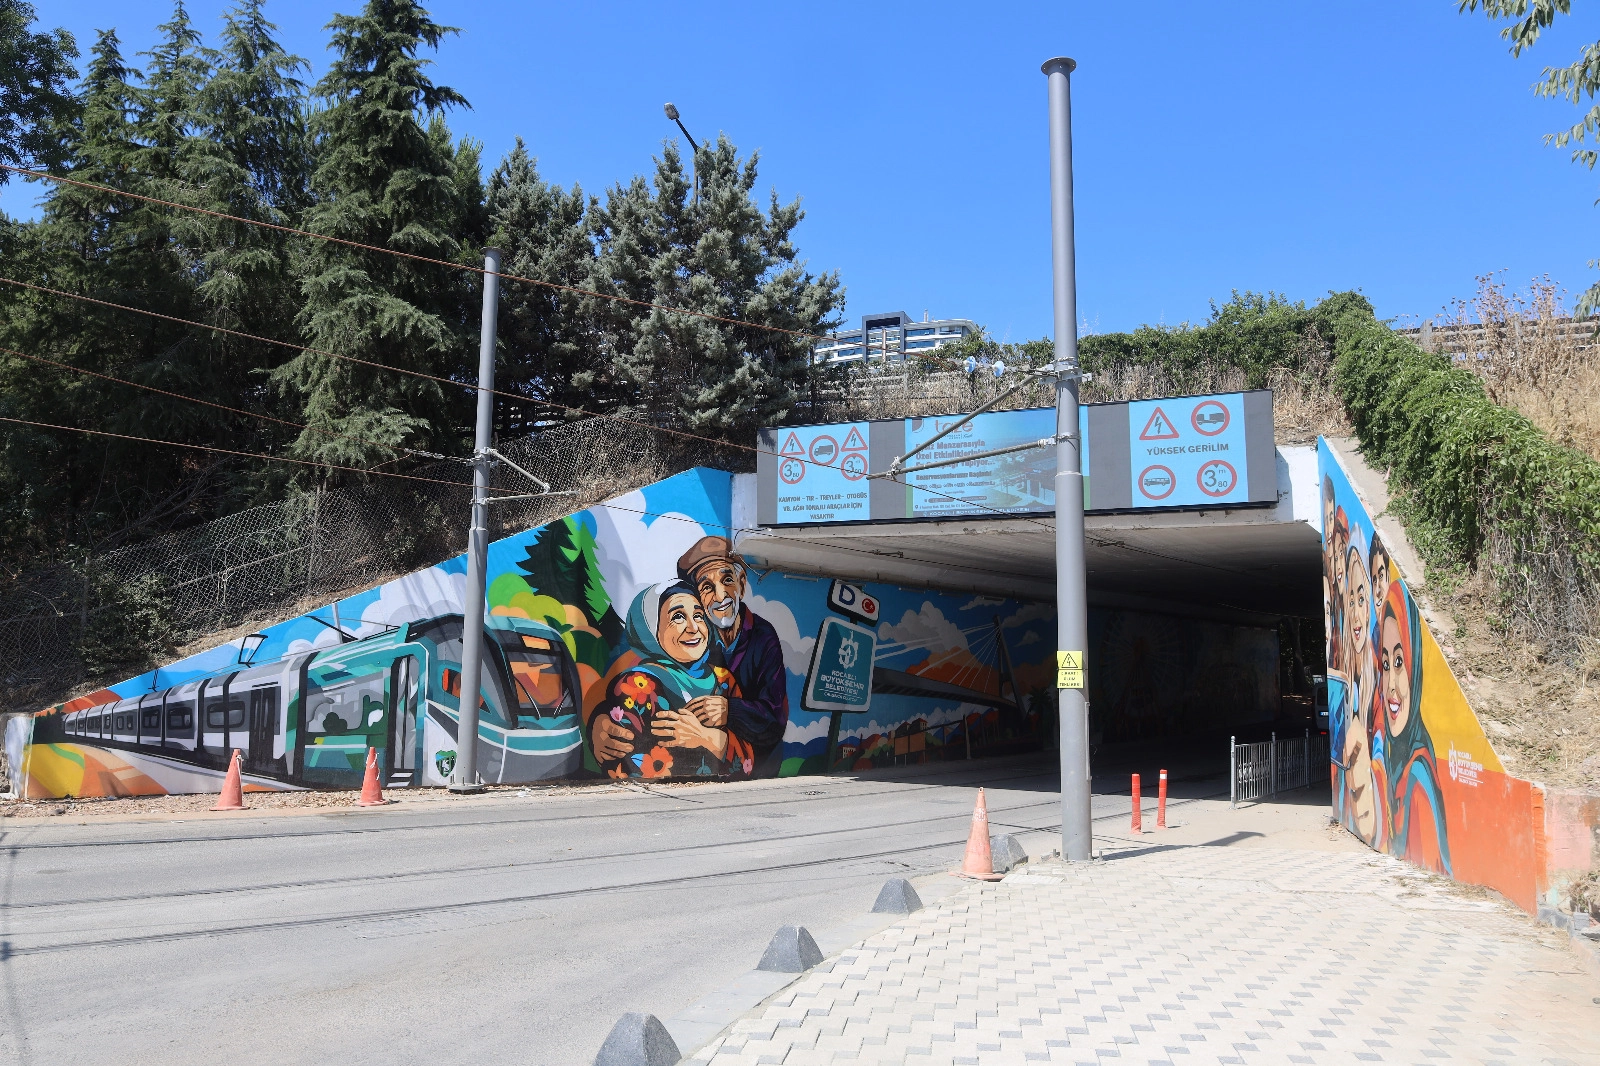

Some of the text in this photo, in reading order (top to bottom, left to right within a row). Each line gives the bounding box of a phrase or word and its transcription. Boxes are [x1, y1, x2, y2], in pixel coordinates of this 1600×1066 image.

[1146, 443, 1229, 456] YÜKSEK GERİLİM
[784, 464, 792, 477] 3
[1204, 469, 1217, 487] 3
